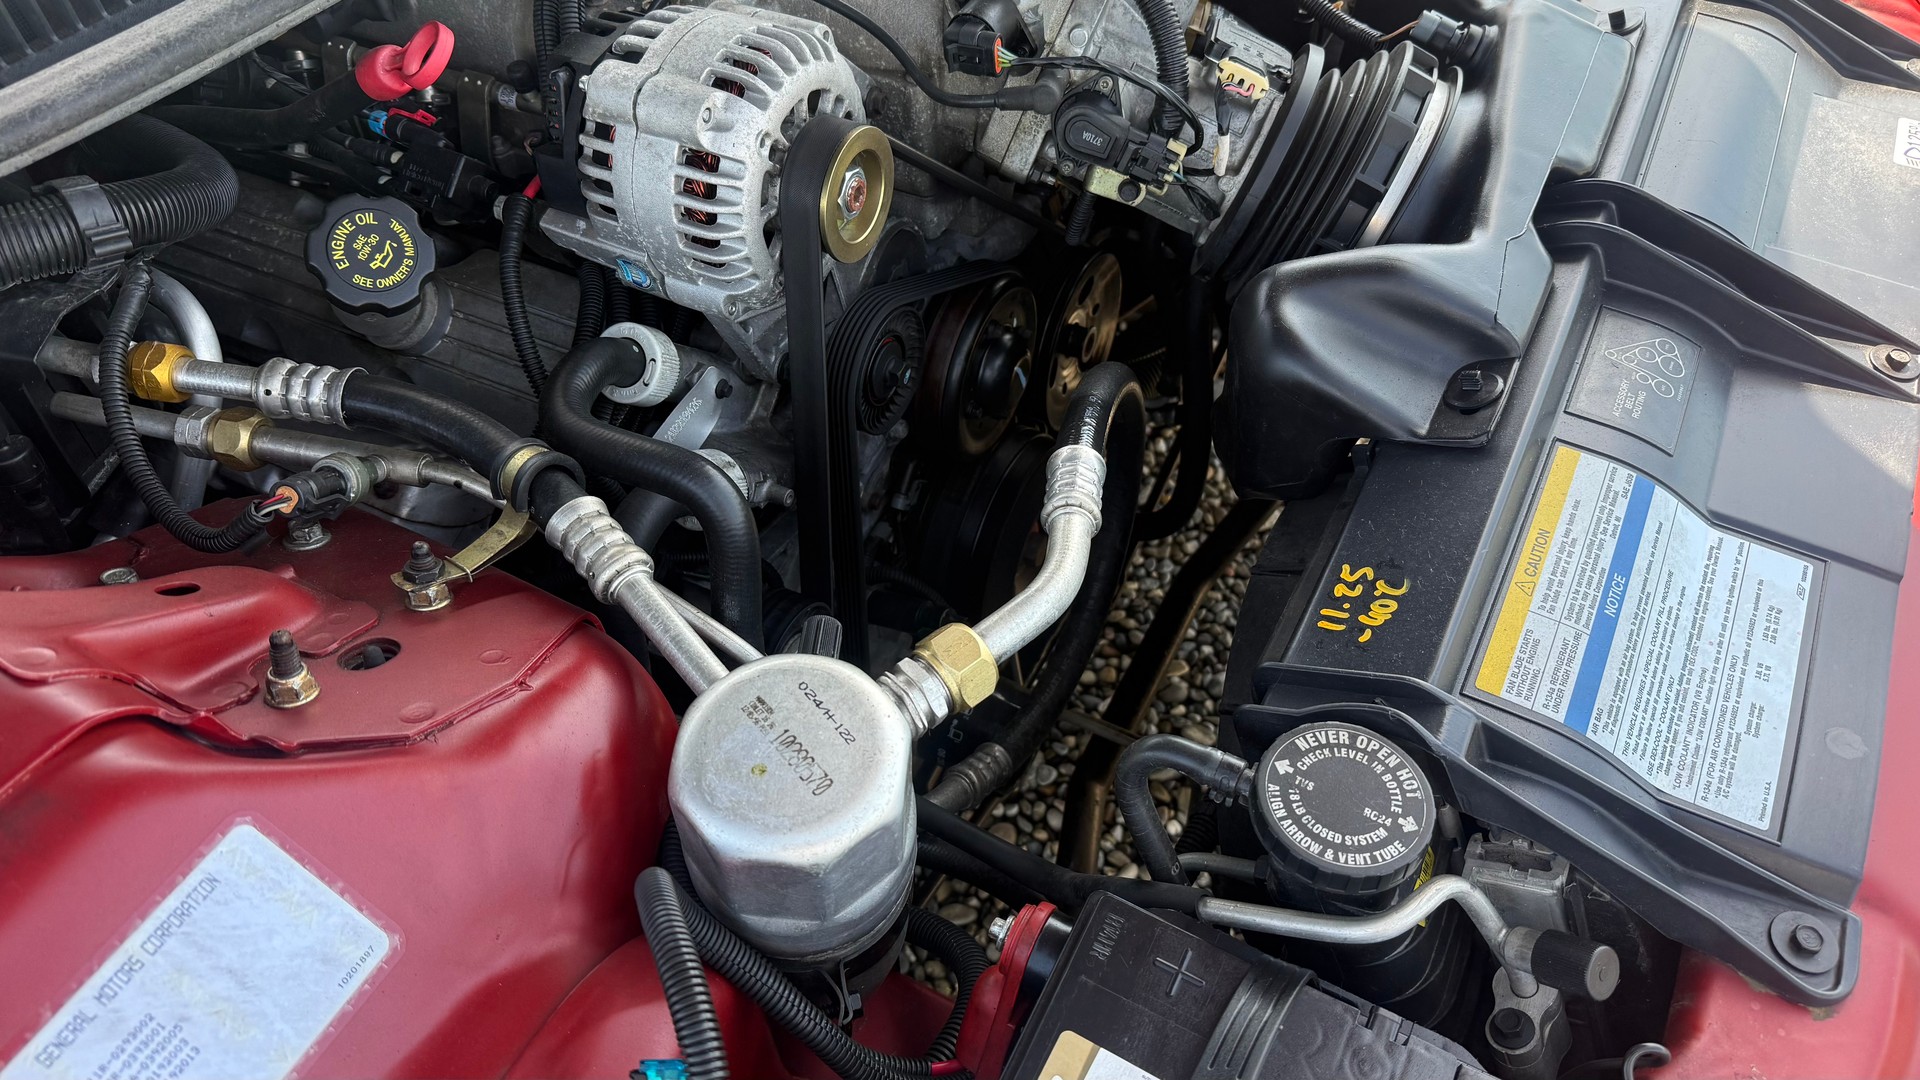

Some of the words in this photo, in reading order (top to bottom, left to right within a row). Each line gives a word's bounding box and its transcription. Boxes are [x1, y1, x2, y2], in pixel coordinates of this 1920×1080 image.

[1083, 130, 1103, 147] 3710A
[332, 219, 356, 270] ENGINE
[356, 213, 378, 225] OIL
[353, 234, 367, 250] SAE
[358, 234, 379, 261] 10W-30
[390, 218, 415, 256] MANUAL
[352, 274, 374, 288] SEE
[376, 258, 413, 288] OWNER'S
[1610, 378, 1631, 416] ACCESSORY
[1624, 392, 1636, 409] BELT
[1630, 390, 1647, 419] ROUTING
[1620, 486, 1630, 499] SAE
[1524, 528, 1550, 577] CAUTION
[1316, 563, 1375, 631] 11.25
[1604, 573, 1625, 617] NOTICE
[1660, 569, 1674, 605] PROCEDURE
[1657, 605, 1665, 619] FILL
[1518, 628, 1533, 655] STARTS
[1650, 617, 1661, 647] COOLANT
[1510, 655, 1525, 679] BLADE
[1514, 664, 1531, 697] WITHOUT
[1525, 637, 1540, 665] ENGINE
[1542, 686, 1556, 710] R-134a
[1549, 637, 1570, 686] REFRIGERANT
[1551, 687, 1565, 713] UNDER
[1558, 667, 1571, 687] HIGH
[1565, 631, 1582, 668] PRESSURE
[1643, 647, 1654, 674] SPECIAL
[1728, 654, 1740, 673] ONLY)
[1505, 679, 1517, 695] FAN
[1523, 668, 1541, 702] RUNNING.
[1695, 666, 1709, 689] Engine)
[1722, 673, 1734, 703] VEHICLES
[1633, 678, 1646, 712] REQUIRES
[798, 681, 856, 745] 024/H-122
[1594, 707, 1604, 723] BAG
[1626, 711, 1638, 740] VEHICLE
[1646, 760, 1655, 776] USE
[1659, 691, 1671, 724] COOLANT
[1666, 674, 1675, 692] ONLY
[1685, 700, 1699, 735] INDICATOR
[1712, 703, 1728, 748] CONDITIONED
[1590, 722, 1599, 736] AIR
[1621, 740, 1631, 757] THIS
[1677, 735, 1690, 771] COOLANT"
[1709, 748, 1719, 762] AIR
[1295, 731, 1349, 751] NEVER
[1356, 736, 1400, 767] OPEN
[1396, 768, 1422, 799] HOT
[1705, 761, 1716, 779] (FOR
[1295, 776, 1314, 791] TVS
[1297, 749, 1332, 770] CHECK
[1334, 748, 1368, 765] LEVEL
[1371, 761, 1385, 774] IN
[1382, 773, 1402, 814] BOTTLE
[1672, 771, 1683, 790] "LOW
[1700, 779, 1712, 802] R-134a
[1268, 783, 1288, 820] ALIGN
[1280, 818, 1323, 854] ARROW
[1324, 849, 1334, 861] &
[1338, 852, 1371, 865] VENT
[1373, 840, 1406, 863] TUBE
[1292, 801, 1306, 815] LB
[1302, 814, 1342, 844] CLOSED
[1345, 827, 1388, 846] SYSTEM
[1363, 807, 1392, 827] RC24
[34, 1003, 99, 1068] GENERAL
[92, 952, 146, 1007] MOTORS
[137, 870, 224, 958] CORPORATION
[335, 944, 377, 990] 10201897
